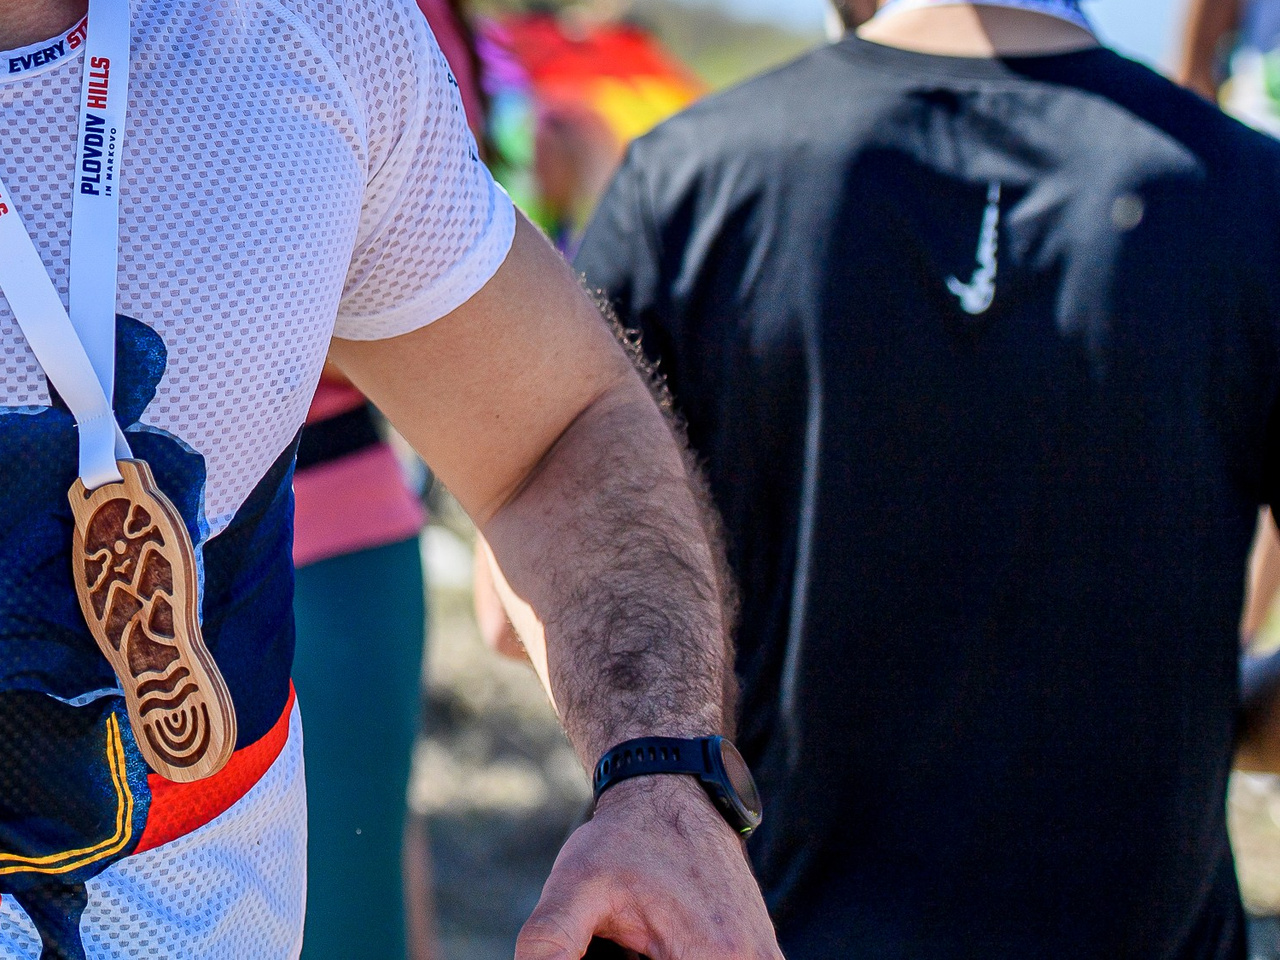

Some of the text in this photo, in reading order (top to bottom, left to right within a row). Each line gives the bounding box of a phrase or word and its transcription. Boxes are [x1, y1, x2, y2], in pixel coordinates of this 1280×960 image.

[8, 39, 65, 74] EVERY
[81, 56, 110, 196] PLOVDIV HILLS
[105, 127, 117, 197] IN MARKOVO
